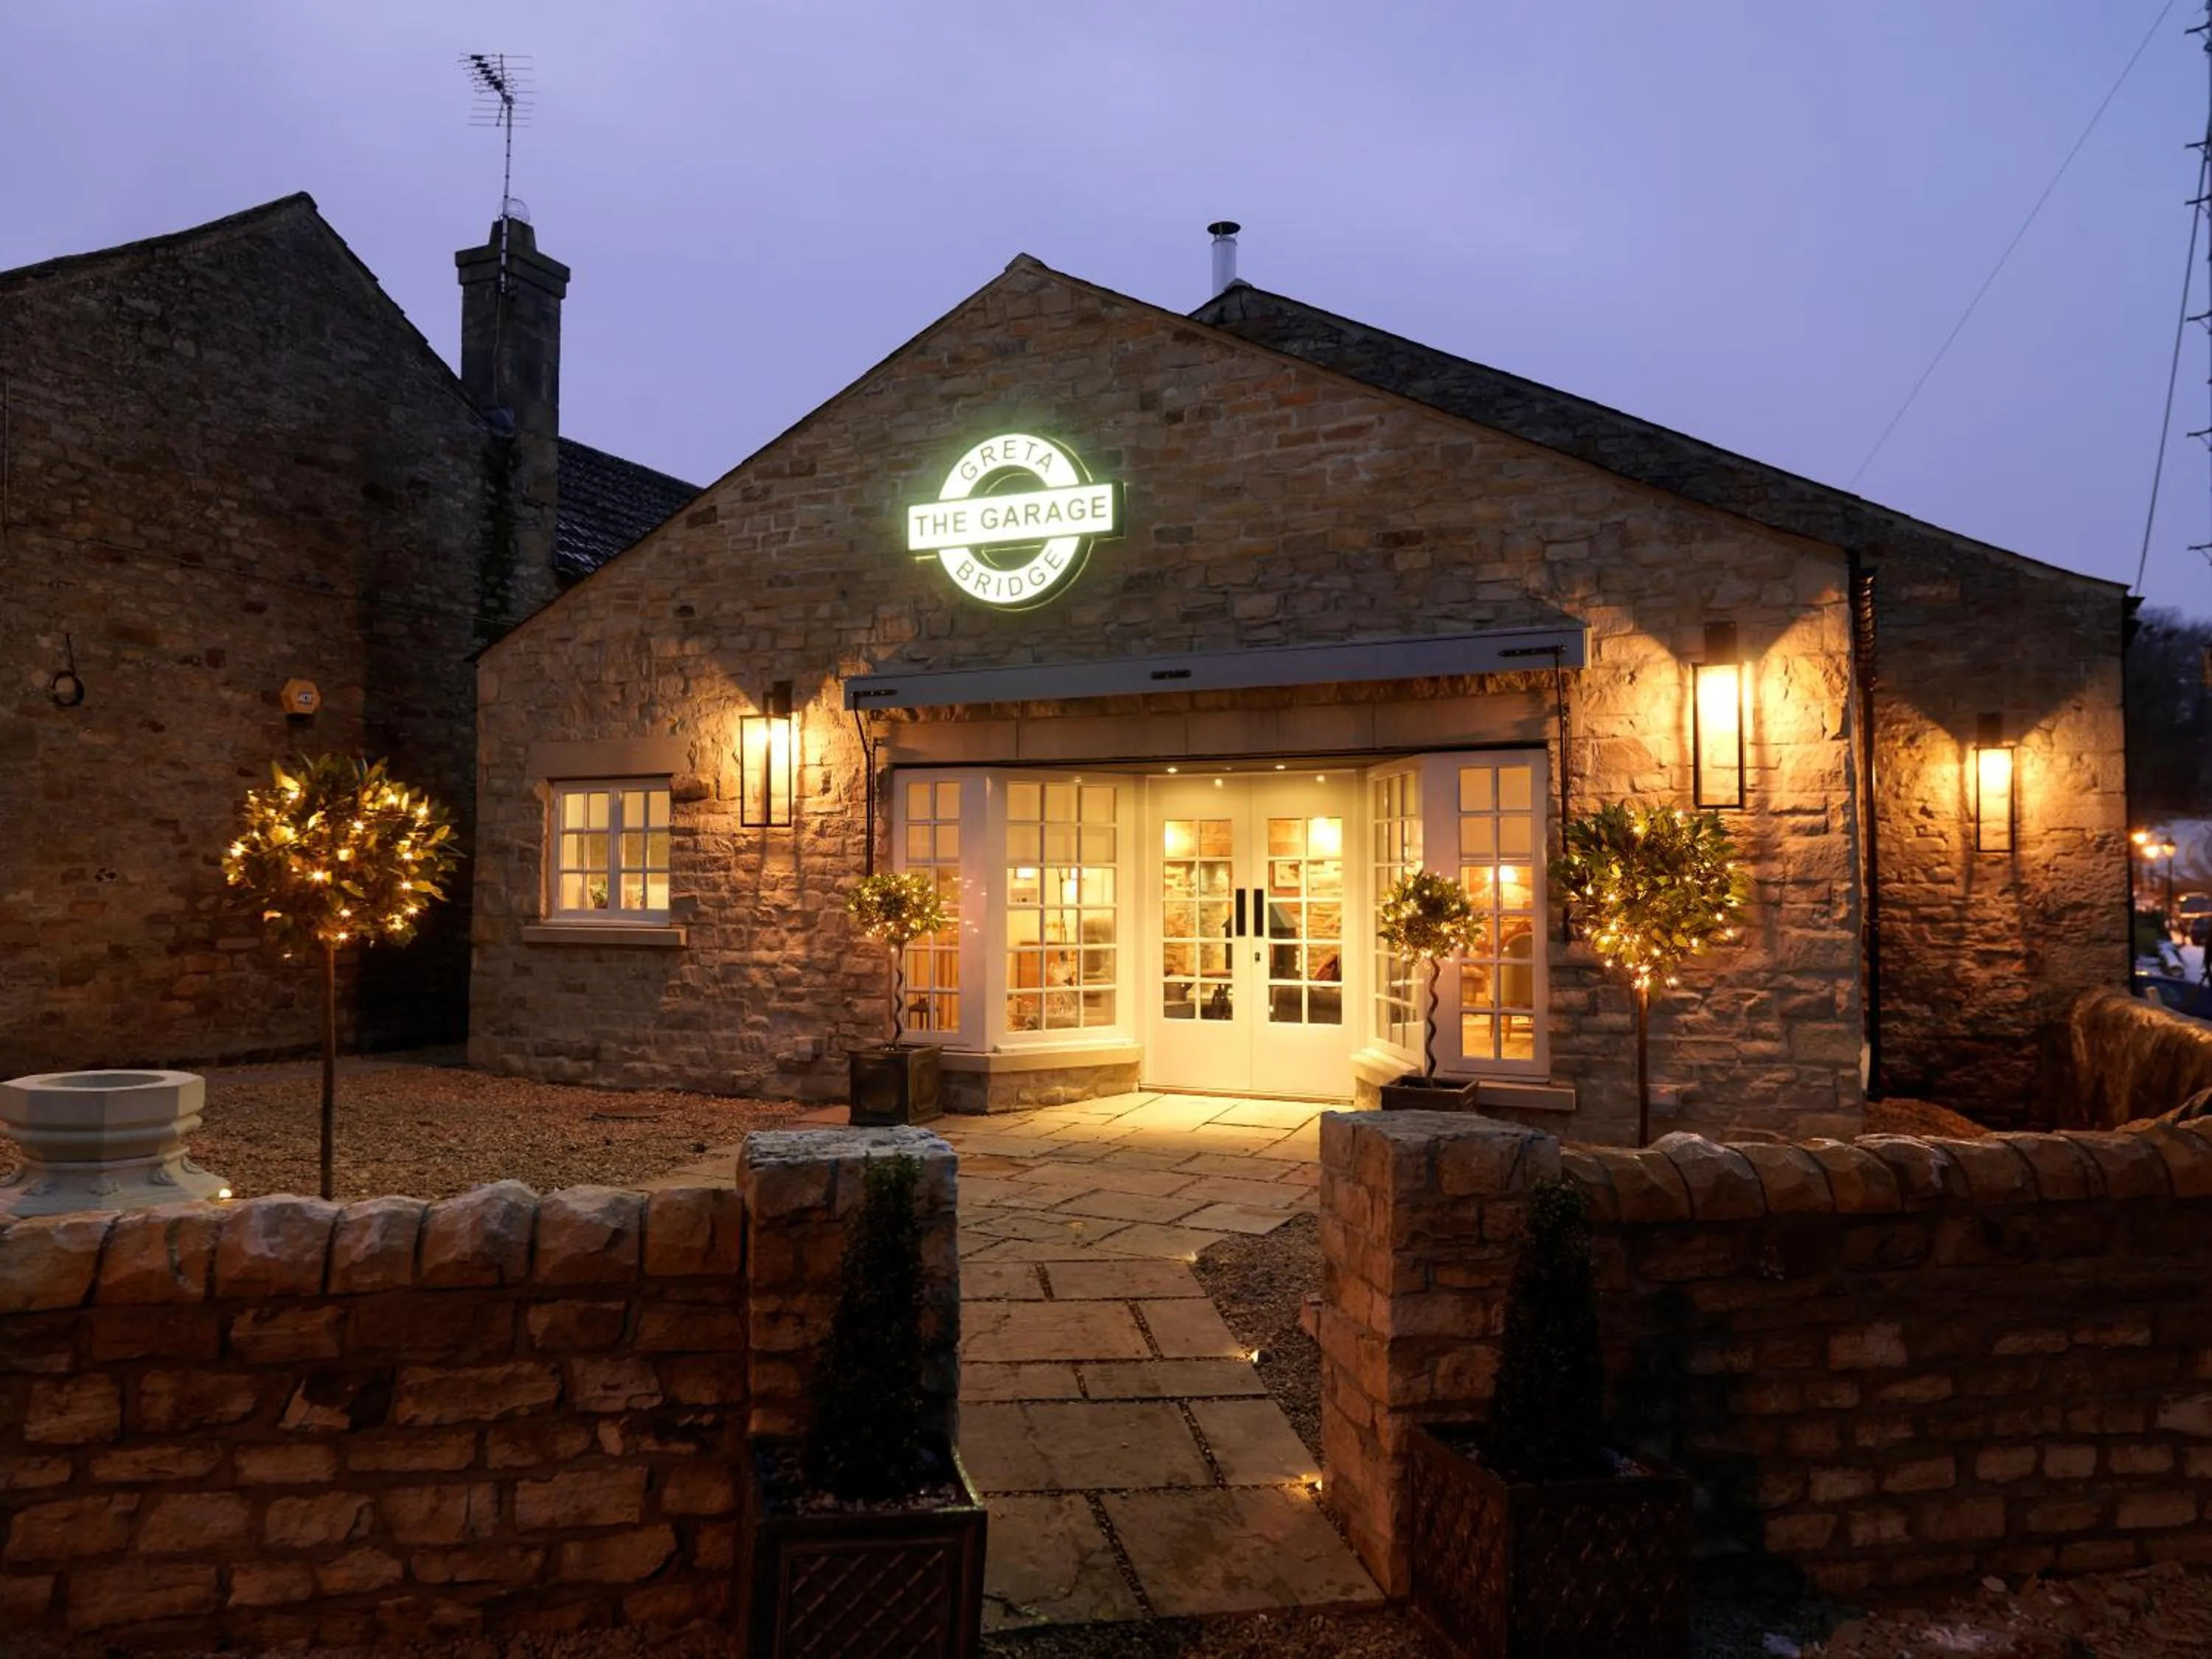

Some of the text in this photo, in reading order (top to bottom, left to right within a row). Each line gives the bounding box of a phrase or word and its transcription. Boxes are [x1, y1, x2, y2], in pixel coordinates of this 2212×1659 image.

[960, 440, 1054, 481] GRETA
[914, 495, 1107, 536] THE GARAGE
[956, 549, 1064, 597] BRIDGE
